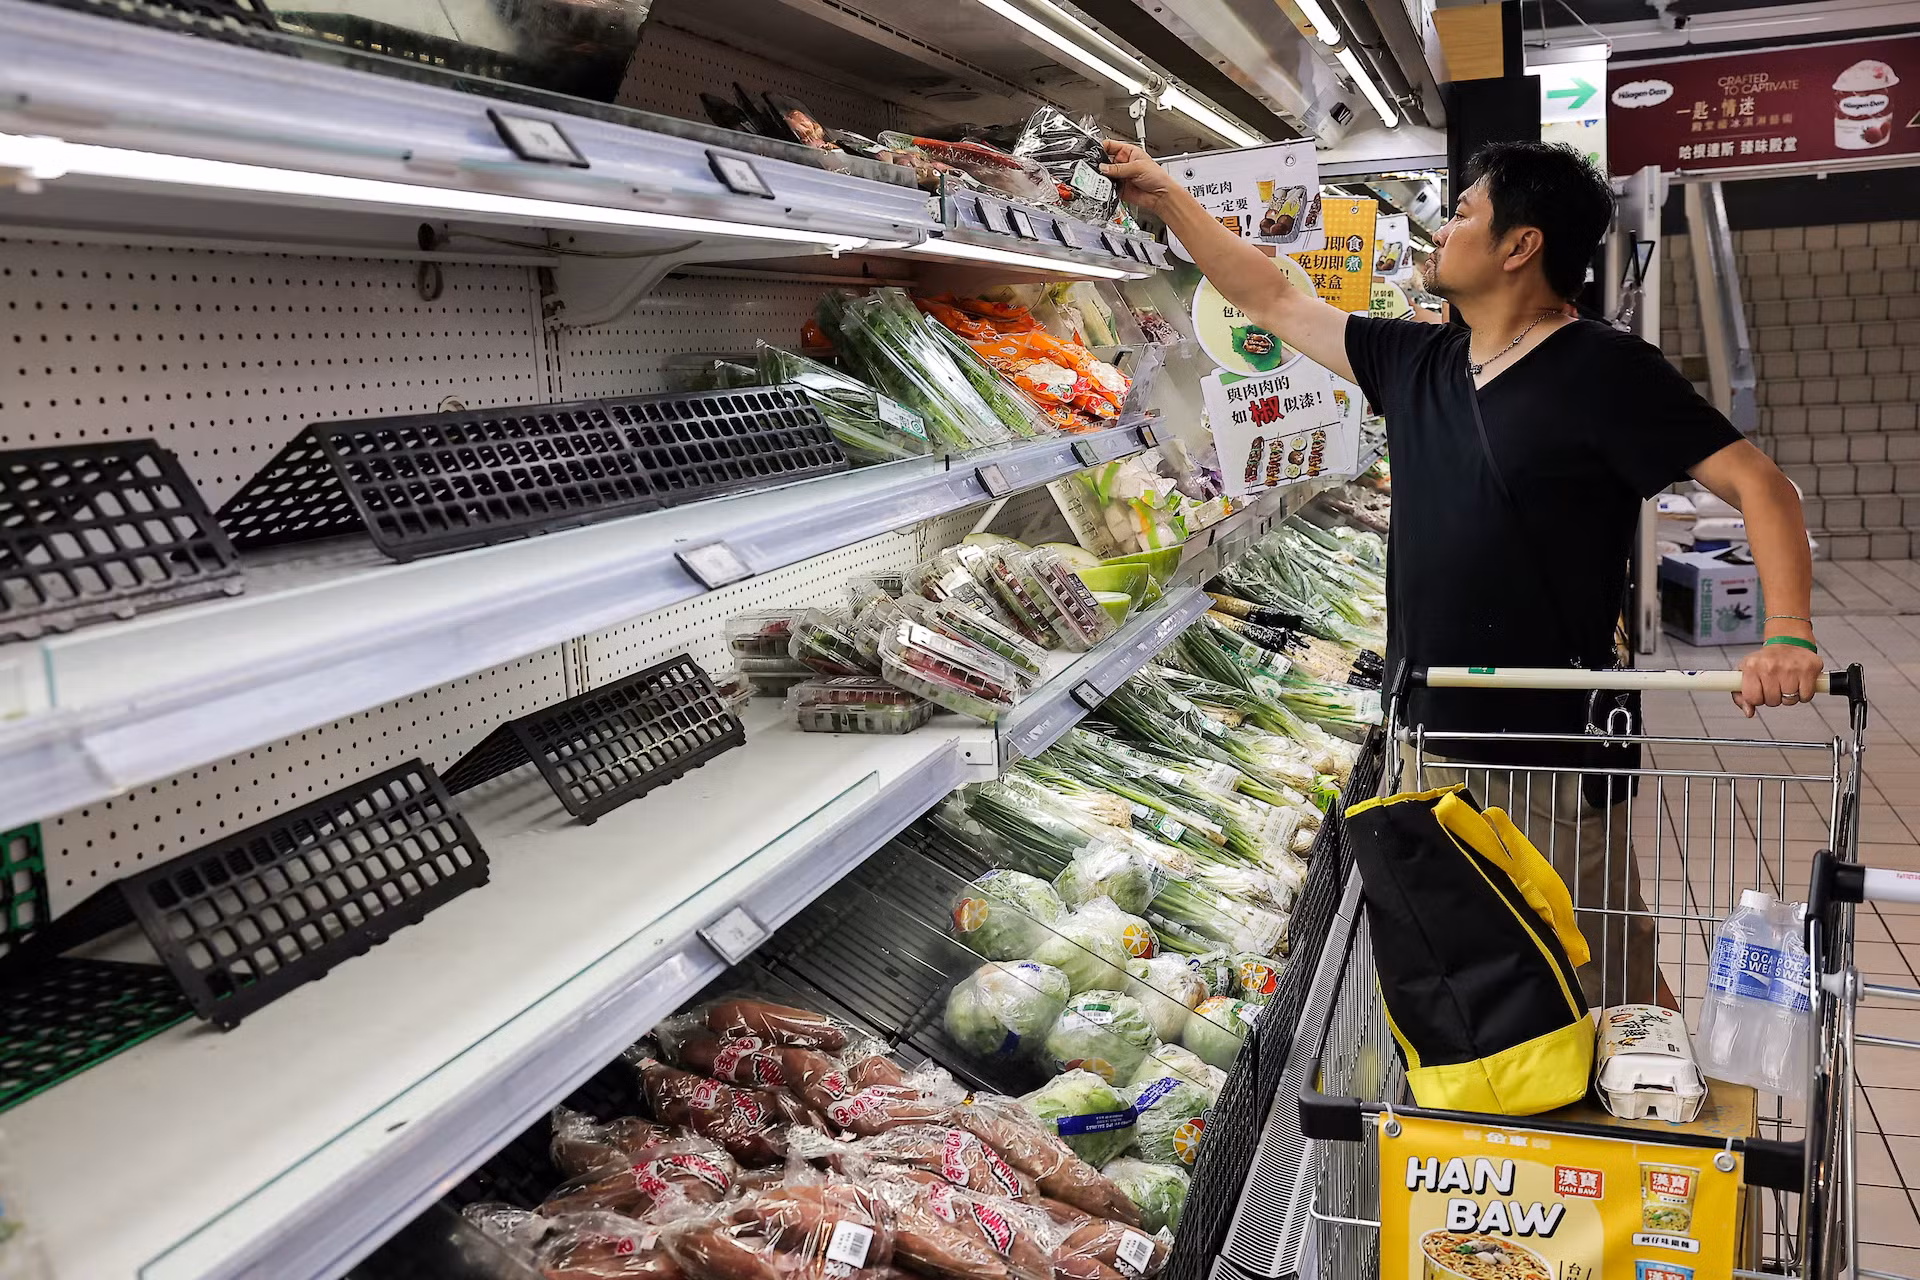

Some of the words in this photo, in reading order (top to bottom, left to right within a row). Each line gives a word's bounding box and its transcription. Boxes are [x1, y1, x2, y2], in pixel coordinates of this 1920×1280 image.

[1718, 73, 1769, 87] CRAFTED
[1724, 85, 1739, 96] TO
[1741, 79, 1799, 94] CAPTIVATE
[1679, 141, 1735, 160] 哈根達斯
[1200, 197, 1249, 213] 一定要
[1323, 235, 1363, 252] 即食
[1298, 254, 1361, 271] 免切即煮
[1308, 273, 1343, 290] 菜盒
[1227, 375, 1290, 404] 與肉肉的
[1406, 1156, 1515, 1196] HAN
[1559, 1169, 1598, 1189] 漢寶
[1652, 1173, 1687, 1190] 漢寶
[1559, 1185, 1577, 1194] HAN
[1578, 1187, 1597, 1195] BAW
[1669, 1186, 1685, 1195] BAW
[1446, 1198, 1566, 1238] BAW
